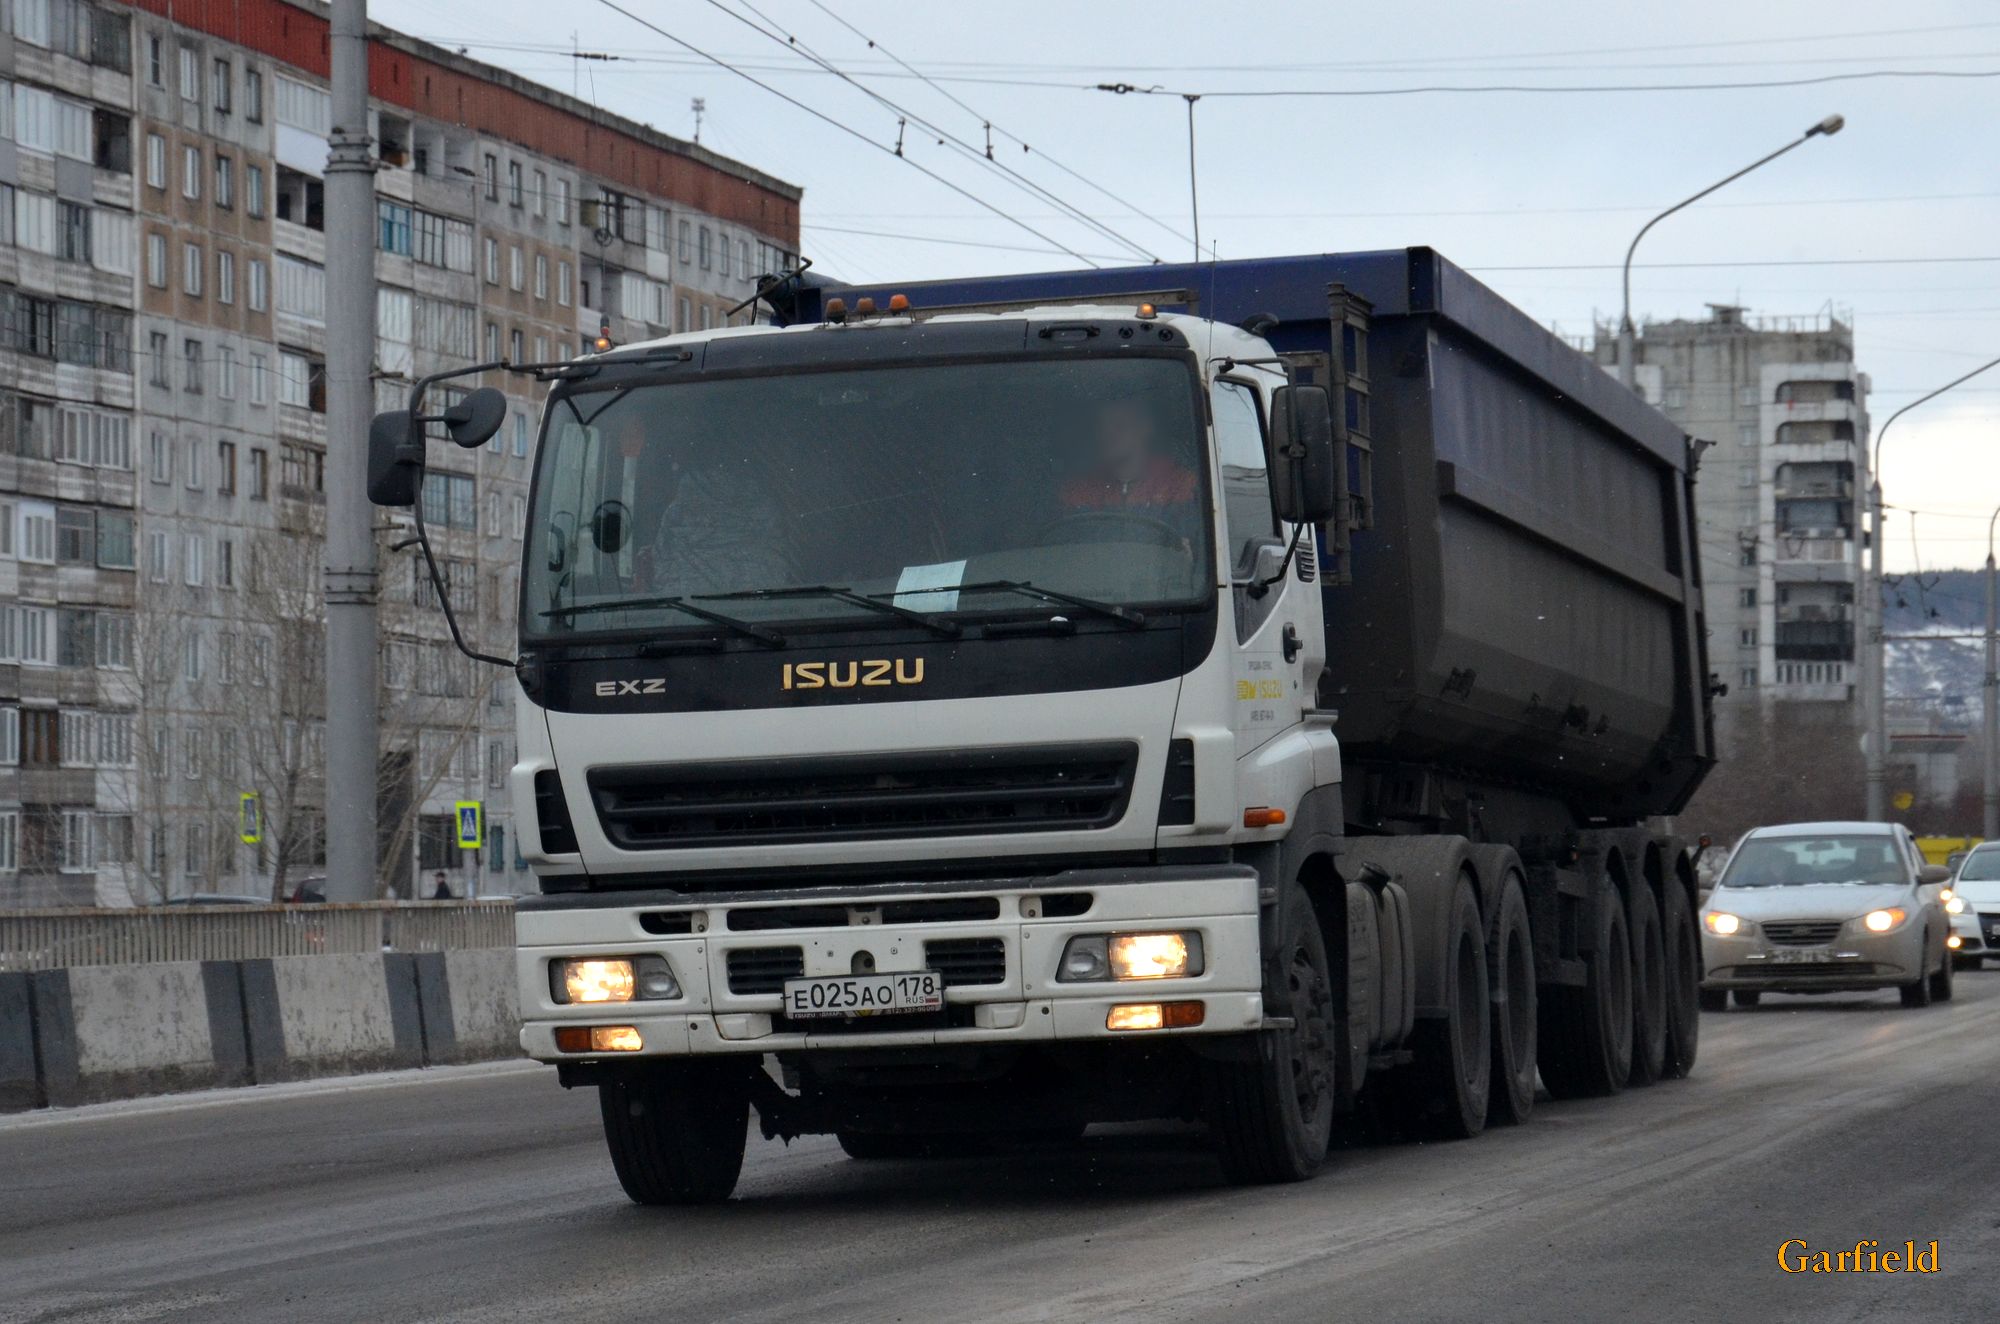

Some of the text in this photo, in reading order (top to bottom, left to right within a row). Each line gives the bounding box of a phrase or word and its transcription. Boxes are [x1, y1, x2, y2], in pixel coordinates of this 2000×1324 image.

[783, 657, 925, 691] ISUZU
[595, 678, 667, 697] EXZ
[897, 976, 935, 997] 178
[905, 996, 925, 1004] RUS
